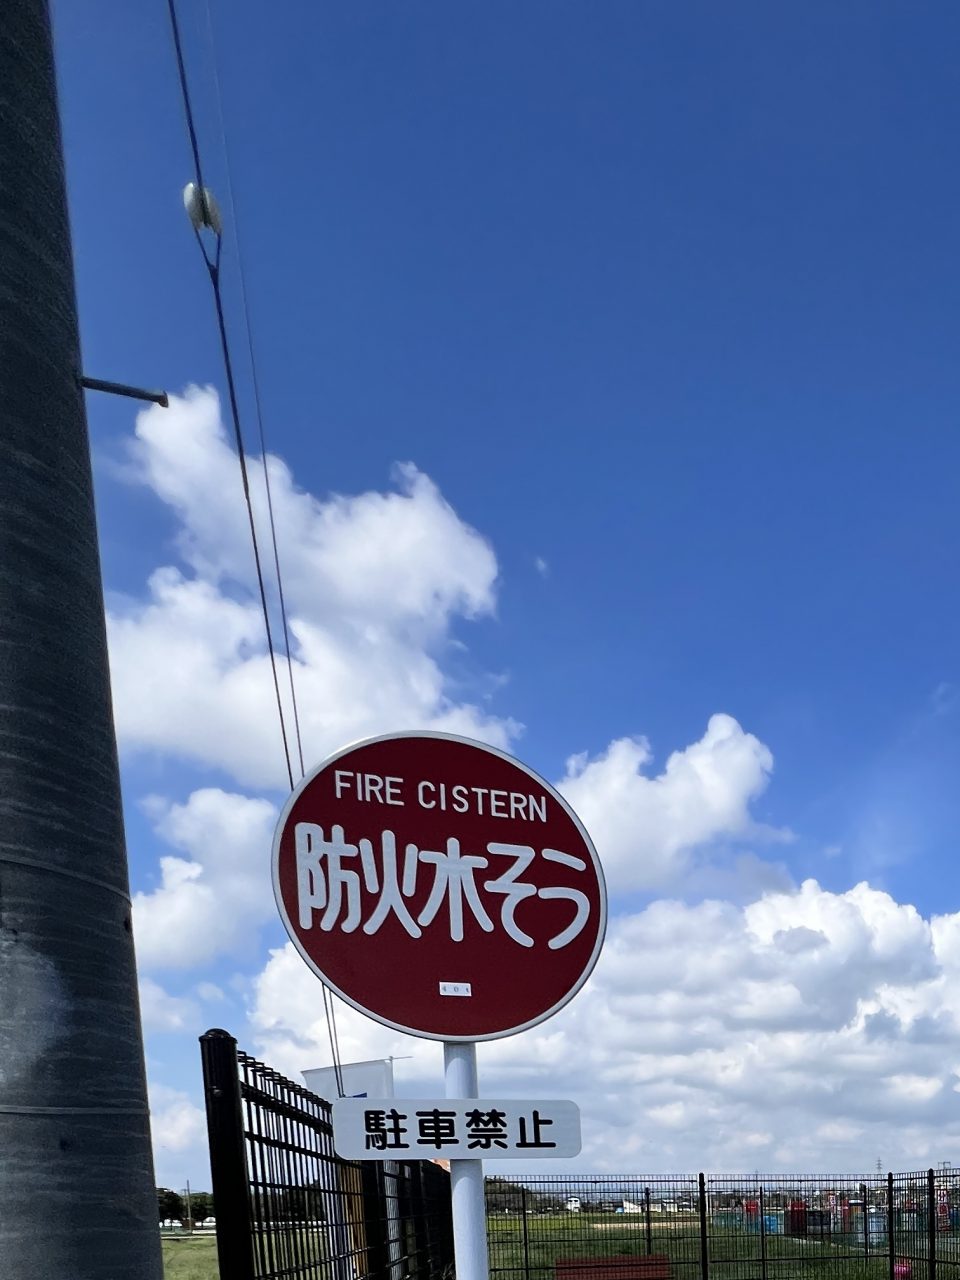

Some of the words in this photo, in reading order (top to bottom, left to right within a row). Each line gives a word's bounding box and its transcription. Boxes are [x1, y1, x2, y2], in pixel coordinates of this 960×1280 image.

[335, 770, 404, 806] FIRE
[418, 781, 547, 822] CISTERN
[295, 822, 591, 949] 防火水そう
[365, 1109, 556, 1150] 駐車禁止
